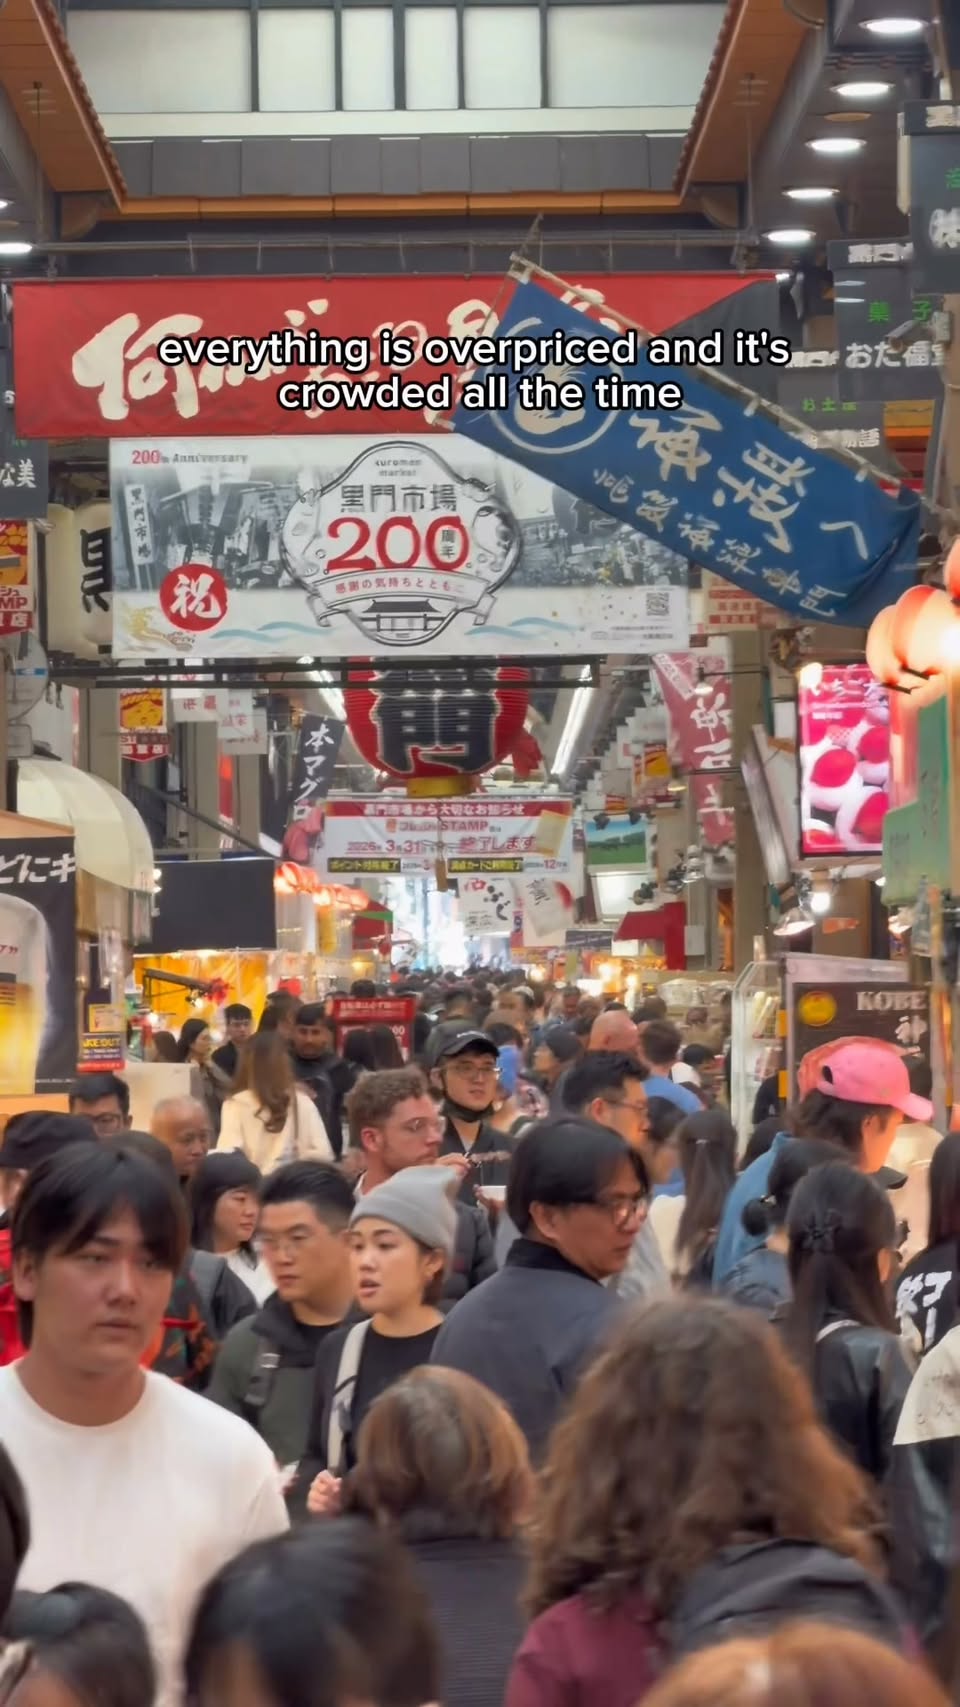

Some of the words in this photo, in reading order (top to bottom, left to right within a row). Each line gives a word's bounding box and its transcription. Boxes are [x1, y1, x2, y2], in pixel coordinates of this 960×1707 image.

[341, 483, 457, 512] 黒門市場
[326, 515, 470, 571] 200
[171, 572, 218, 619] 祝
[292, 722, 335, 821] 本マグロ
[856, 991, 928, 1011] KOBE
